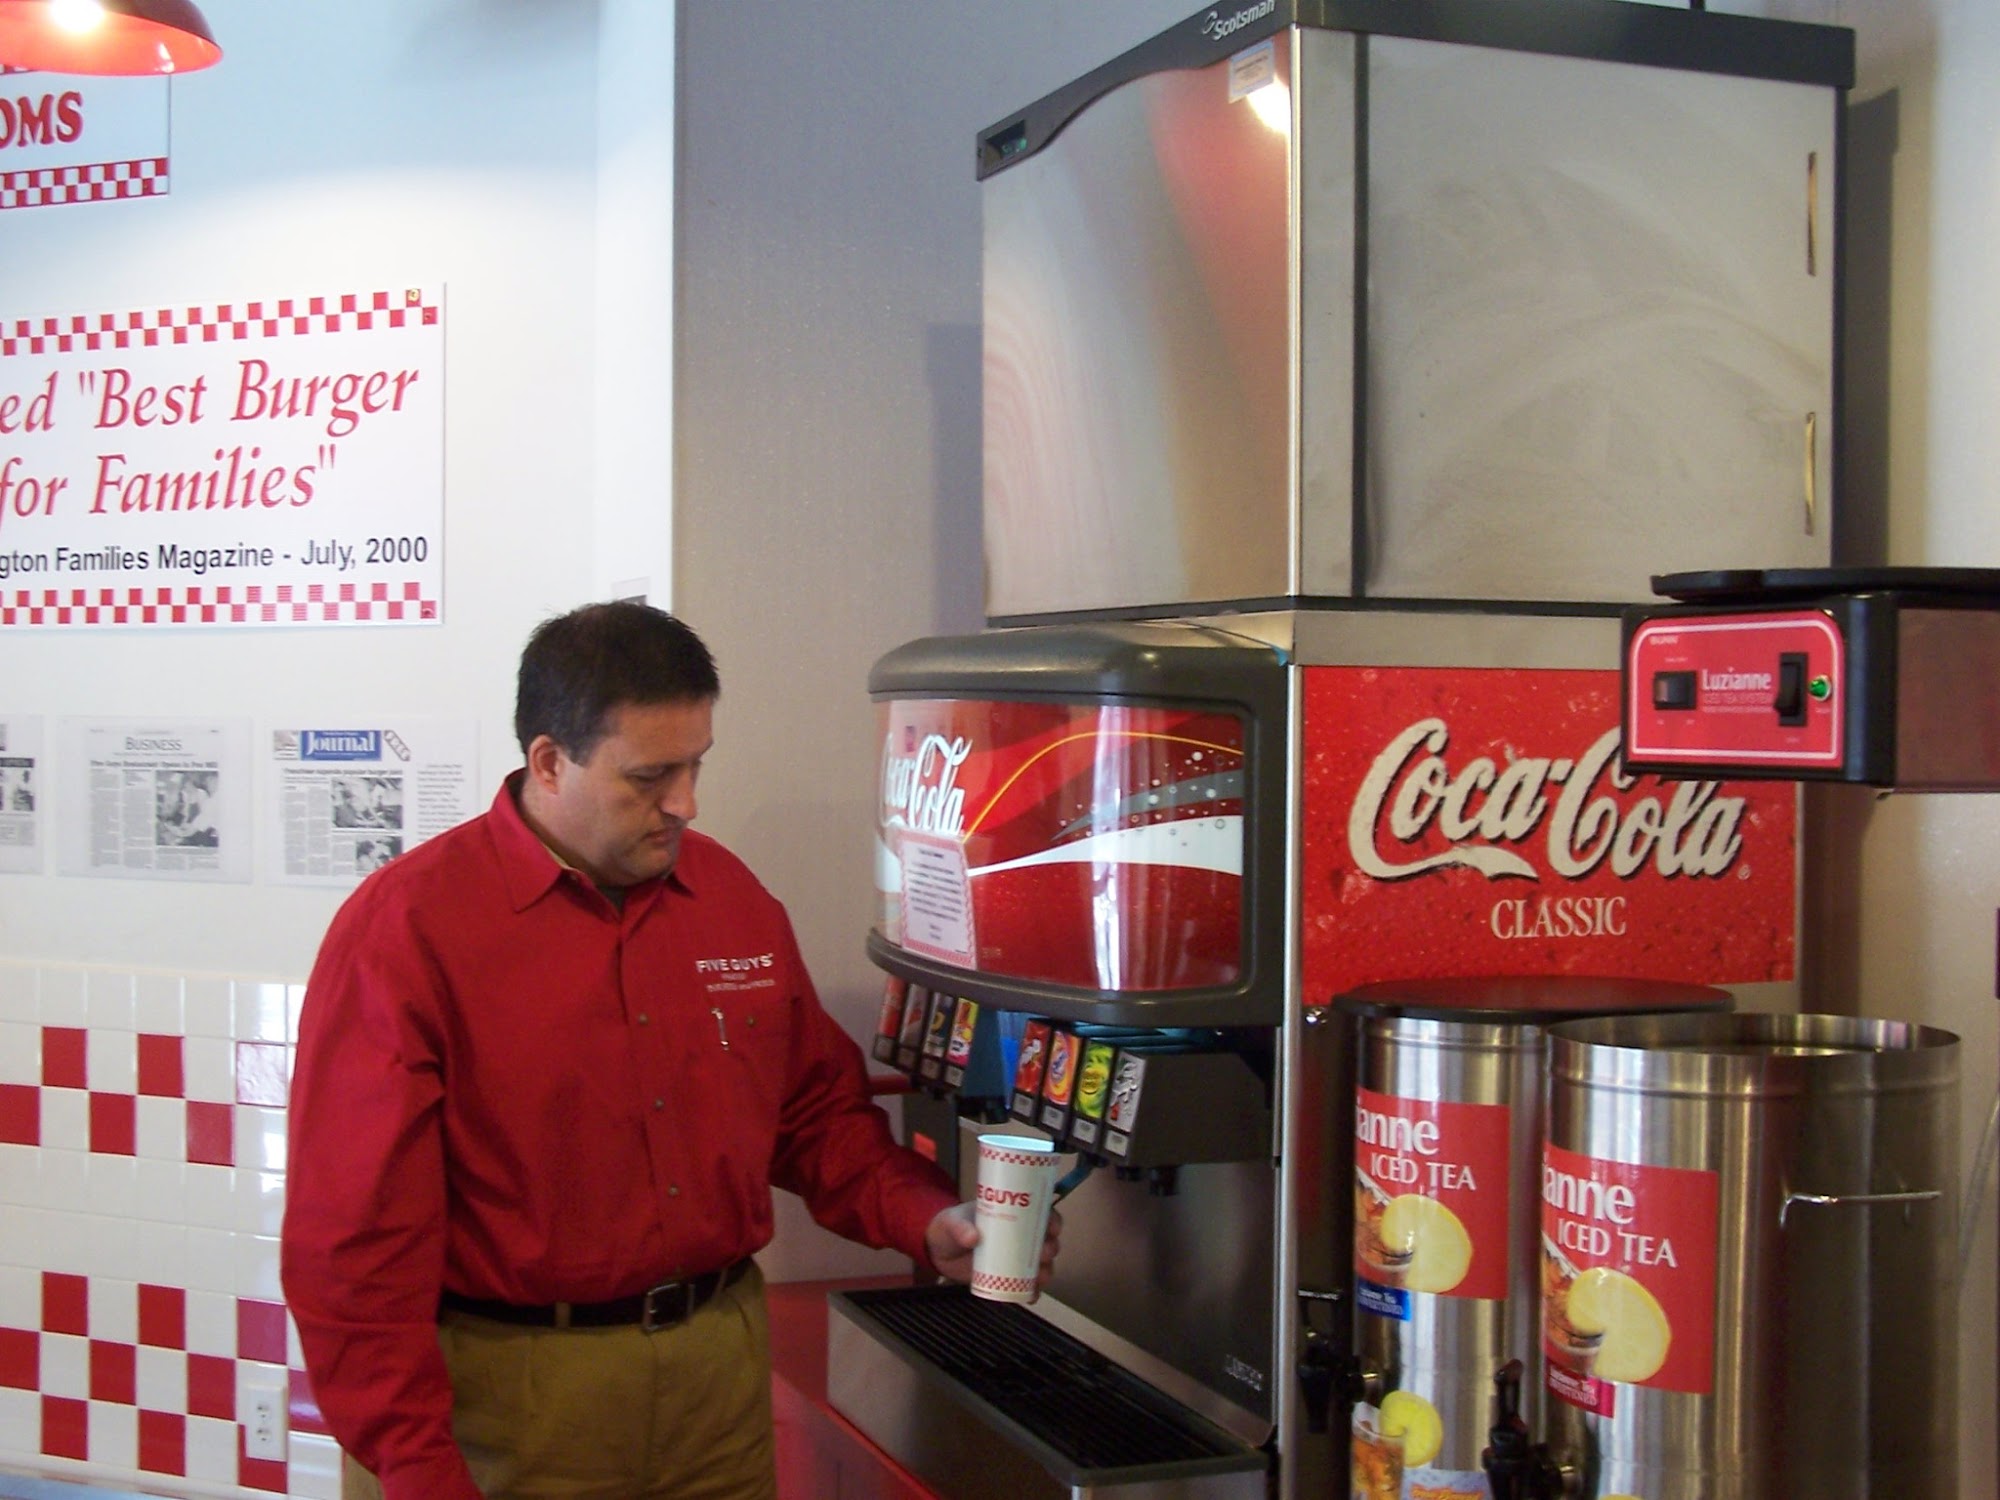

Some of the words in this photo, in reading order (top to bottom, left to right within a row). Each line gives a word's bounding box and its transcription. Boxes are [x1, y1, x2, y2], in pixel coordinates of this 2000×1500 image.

[1212, 0, 1275, 40] Scotsman
[78, 367, 208, 429] "Best
[230, 359, 419, 437] Burger
[0, 457, 68, 530] for
[89, 444, 336, 515] Families"
[56, 545, 149, 571] Families
[157, 541, 274, 575] Magazine
[301, 539, 356, 570] July,
[365, 537, 428, 564] 2000
[1702, 667, 1771, 690] Luzianne
[306, 731, 375, 756] Journal
[1347, 717, 1746, 882] Coca-Cola
[1491, 896, 1628, 939] CLASSIC
[696, 958, 730, 973] FIVE
[731, 954, 773, 971] GUYS
[1371, 1152, 1419, 1184] ICED
[1425, 1161, 1477, 1191] TEA
[985, 1187, 1030, 1208] GUYS
[1557, 1218, 1611, 1256] ICED
[1617, 1230, 1677, 1269] TEA
